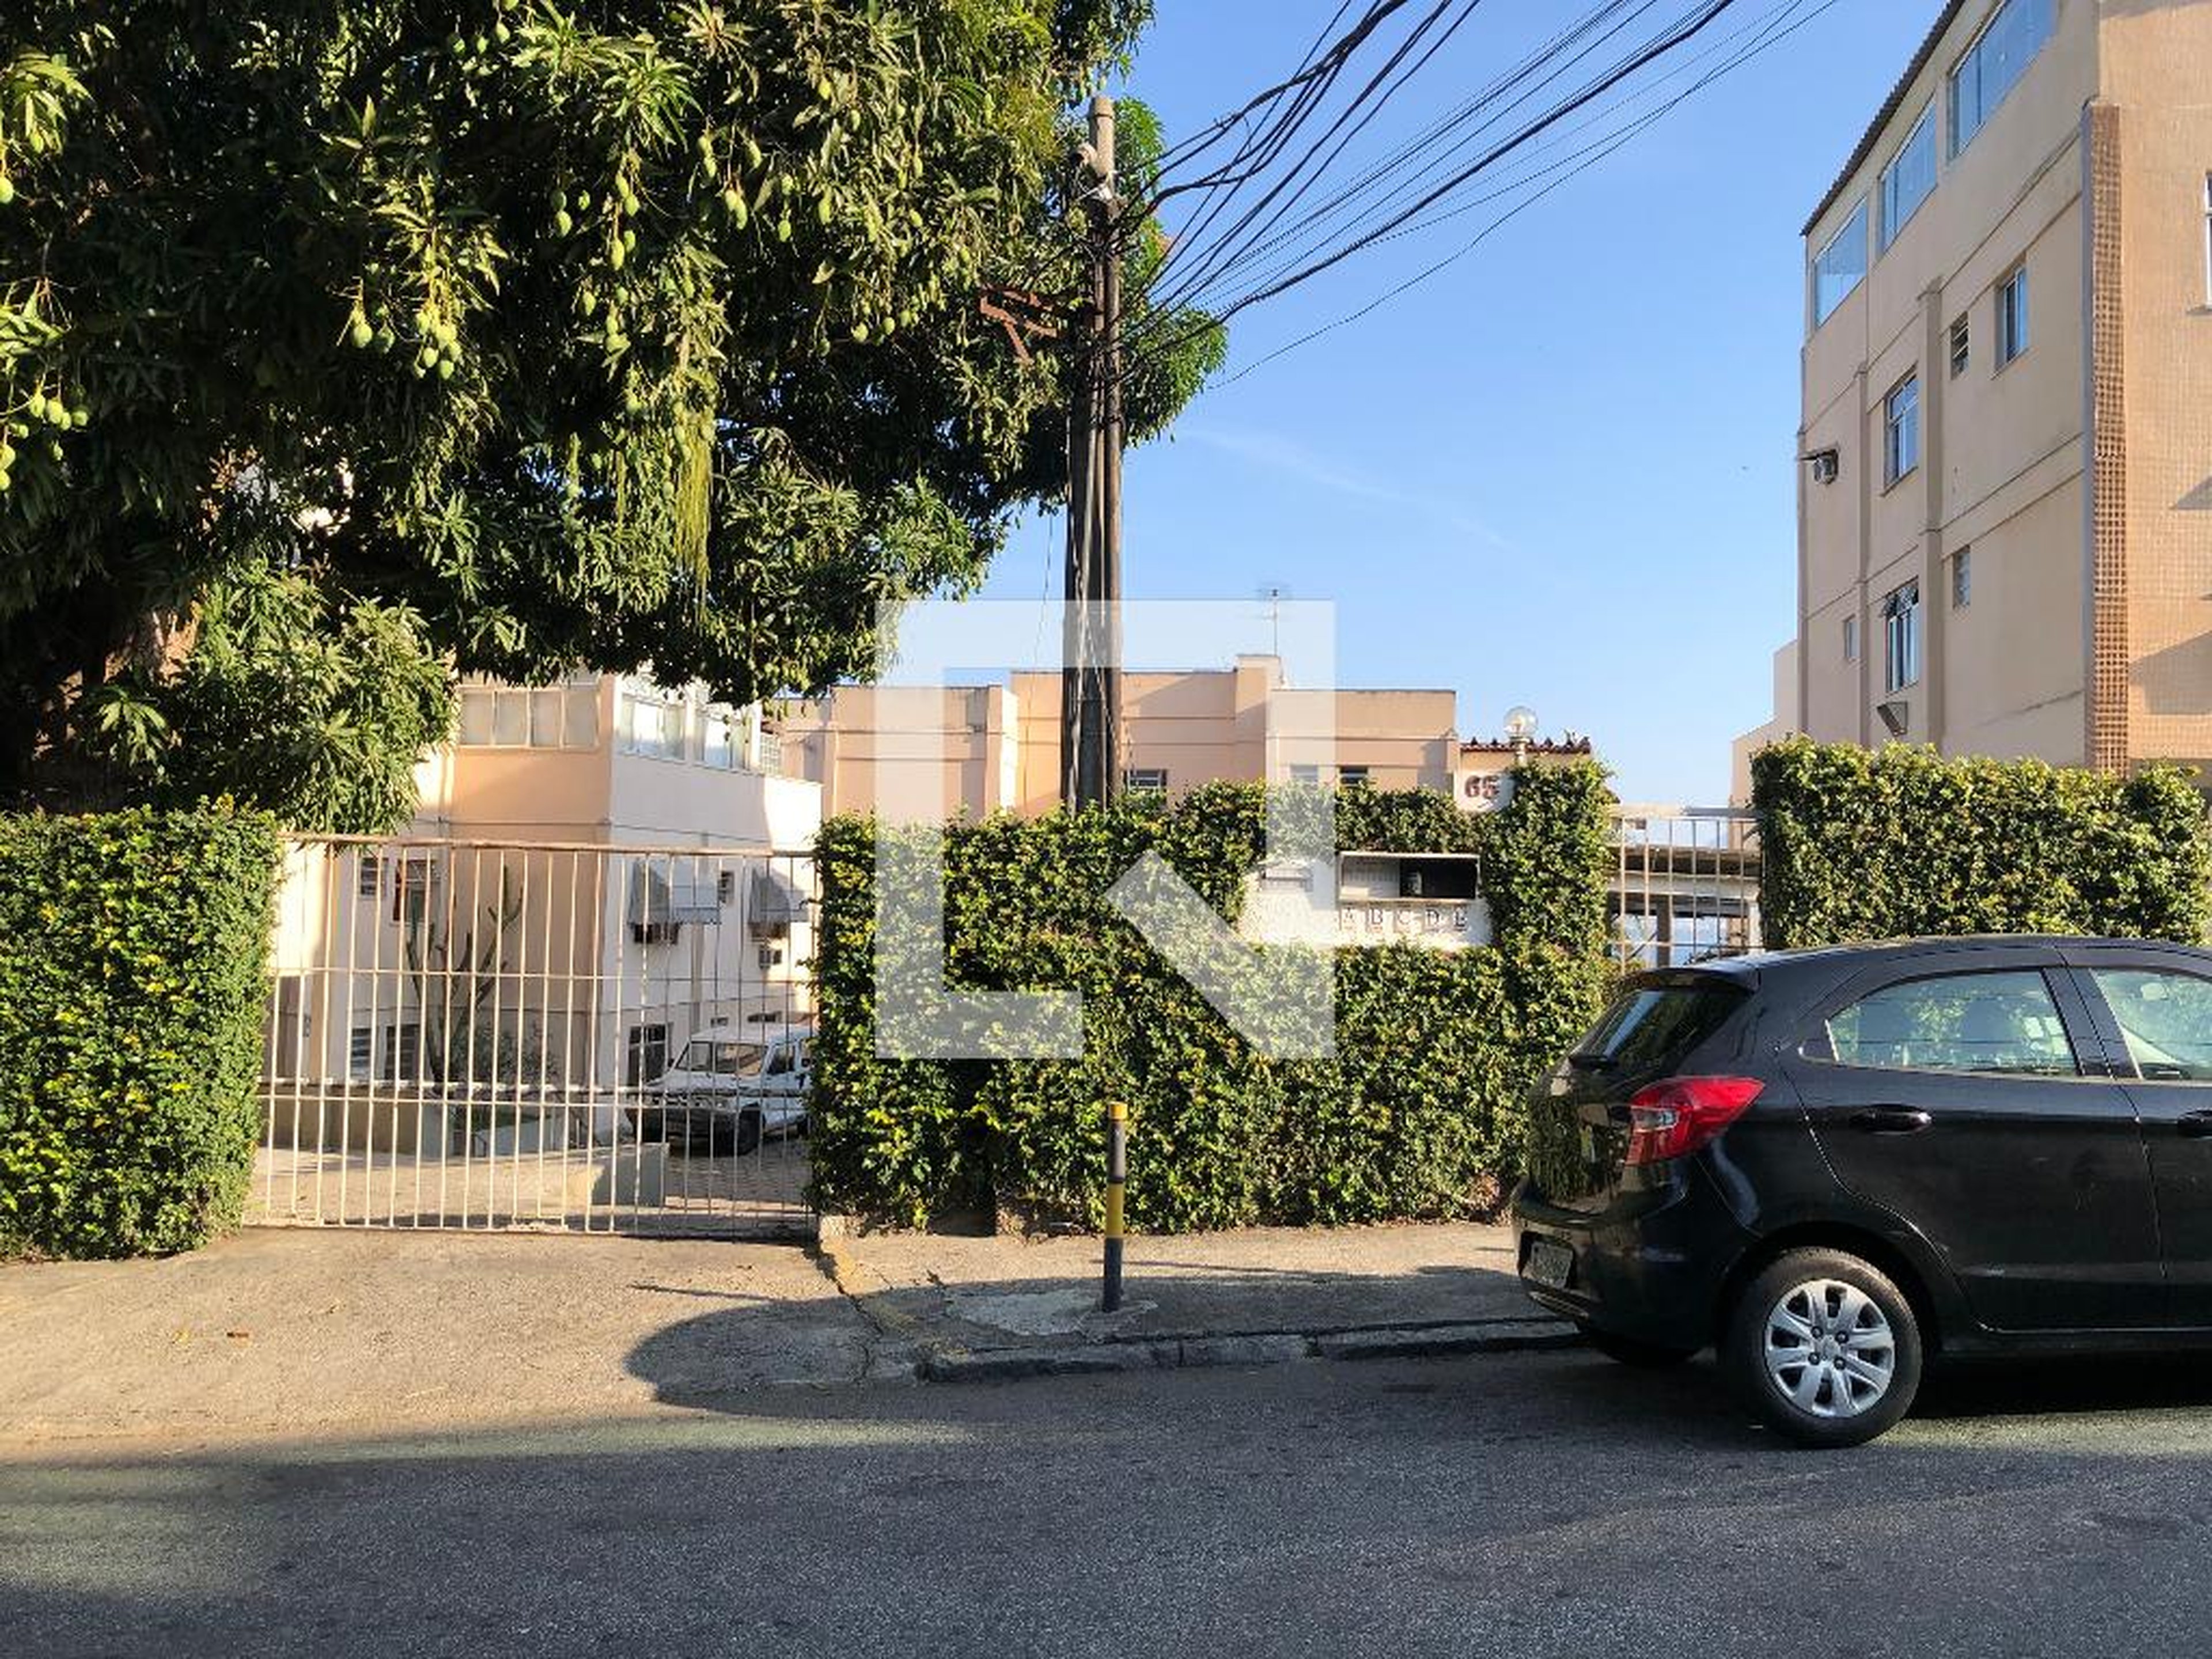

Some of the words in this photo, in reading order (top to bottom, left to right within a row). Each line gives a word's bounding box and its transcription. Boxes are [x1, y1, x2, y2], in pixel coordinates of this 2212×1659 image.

[1465, 775, 1499, 800] 65
[1371, 907, 1383, 925] B
[1426, 909, 1440, 926] D
